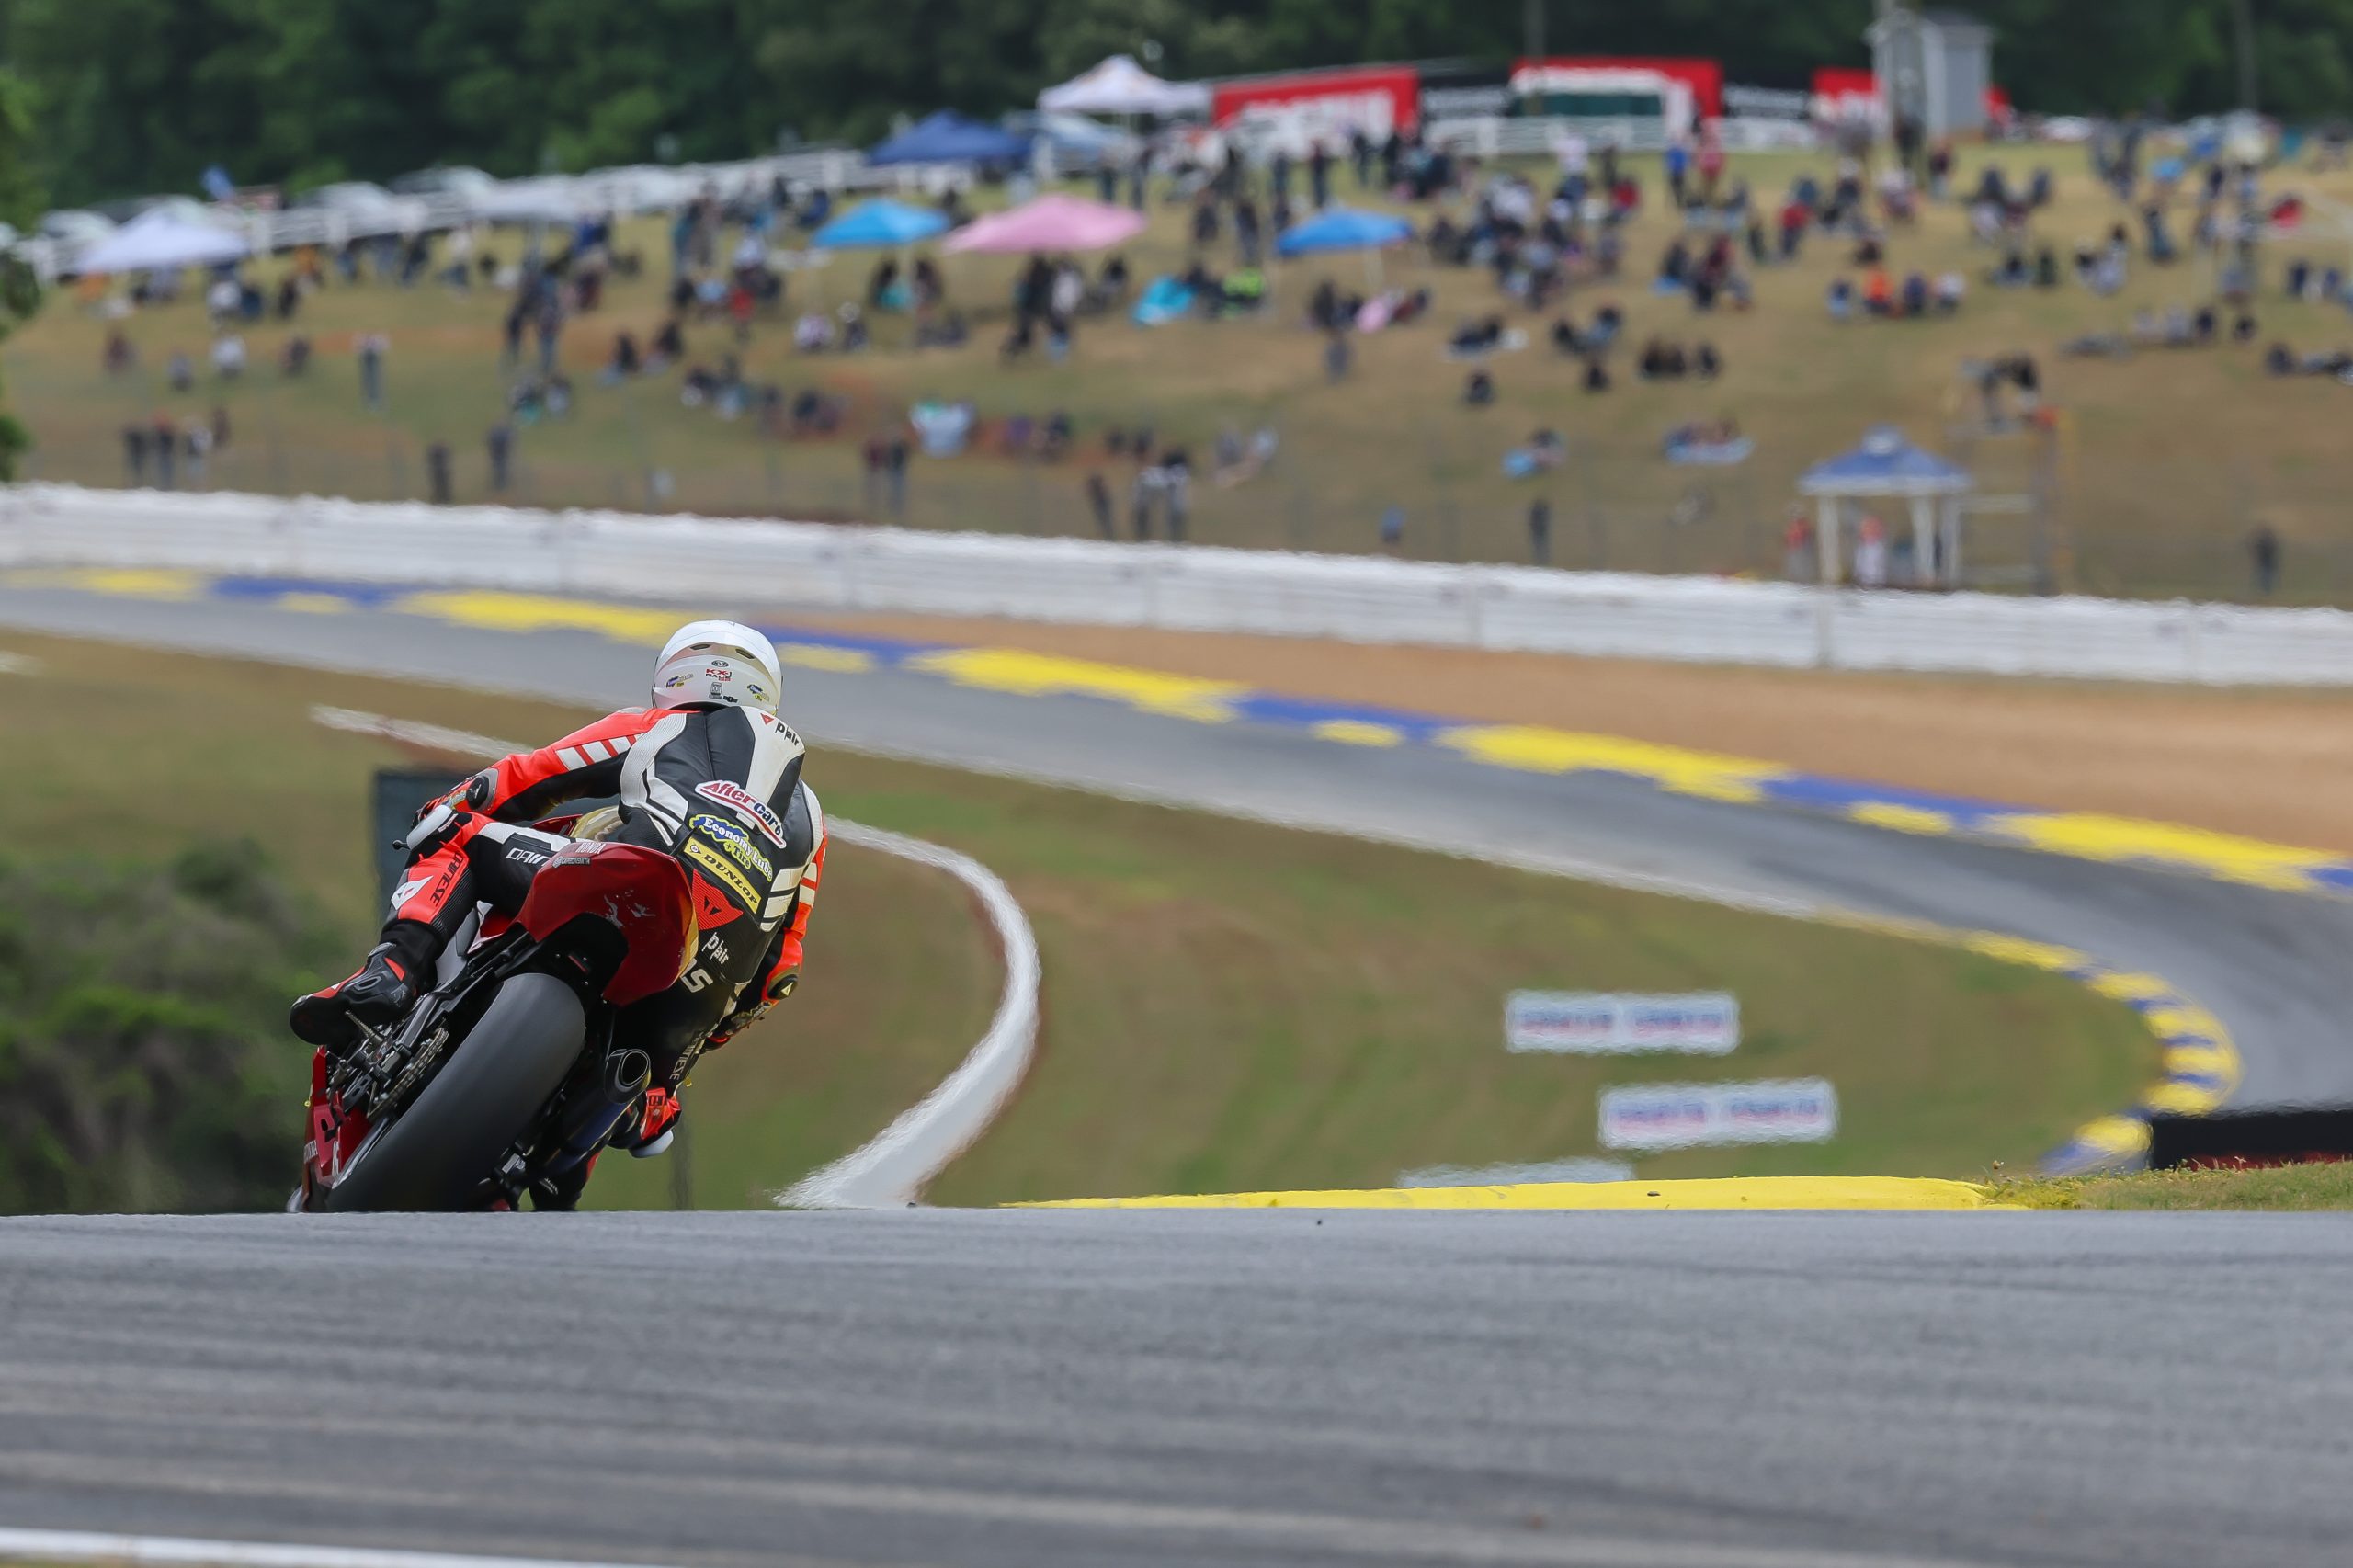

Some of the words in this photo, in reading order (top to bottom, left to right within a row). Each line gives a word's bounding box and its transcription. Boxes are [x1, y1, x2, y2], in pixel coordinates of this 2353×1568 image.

[703, 817, 753, 856] Economy
[752, 851, 773, 881] Lube
[702, 854, 758, 904] DUNLOP
